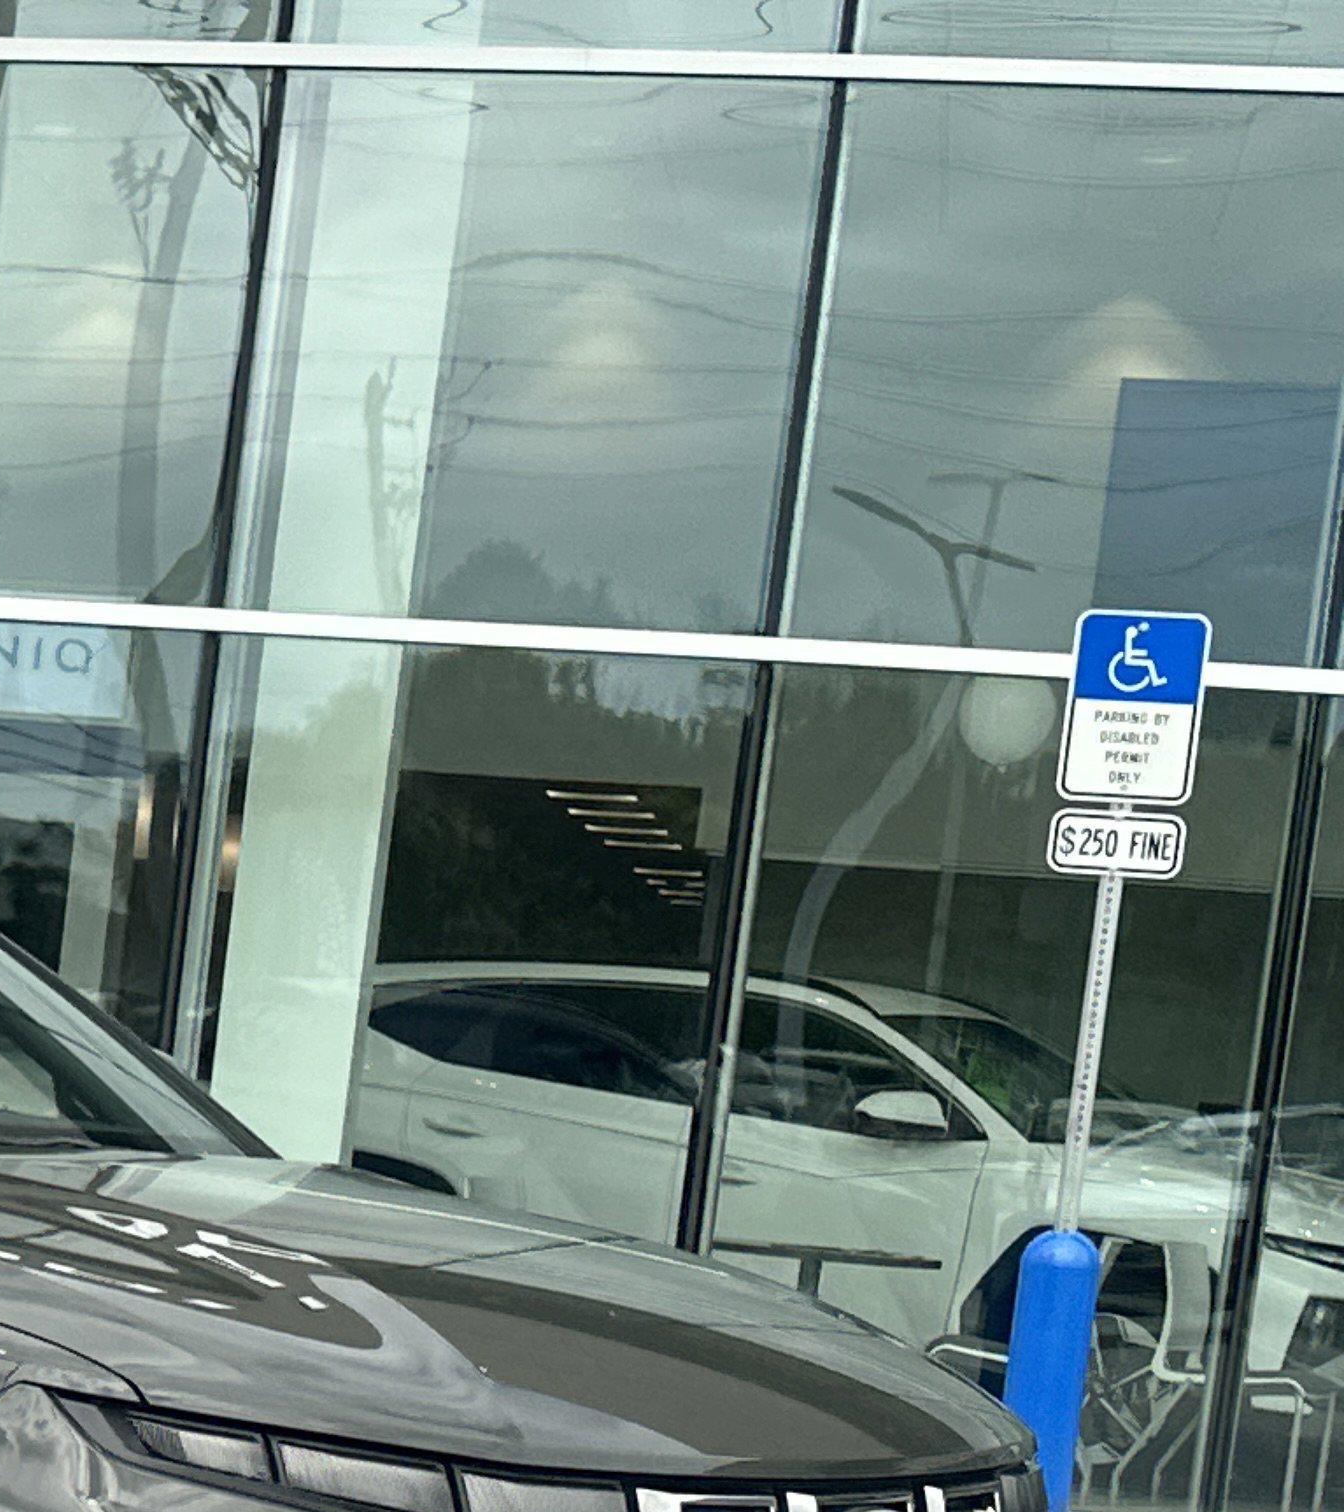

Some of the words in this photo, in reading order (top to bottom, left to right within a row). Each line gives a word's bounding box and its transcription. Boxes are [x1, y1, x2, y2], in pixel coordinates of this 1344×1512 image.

[1094, 710, 1148, 725] PARKING
[1154, 713, 1170, 726] BY
[1100, 730, 1160, 745] DISABLED
[1105, 751, 1150, 764] PERMIT
[1108, 771, 1141, 784] ONLY
[1060, 826, 1119, 857] $250
[1130, 832, 1174, 860] FINE
